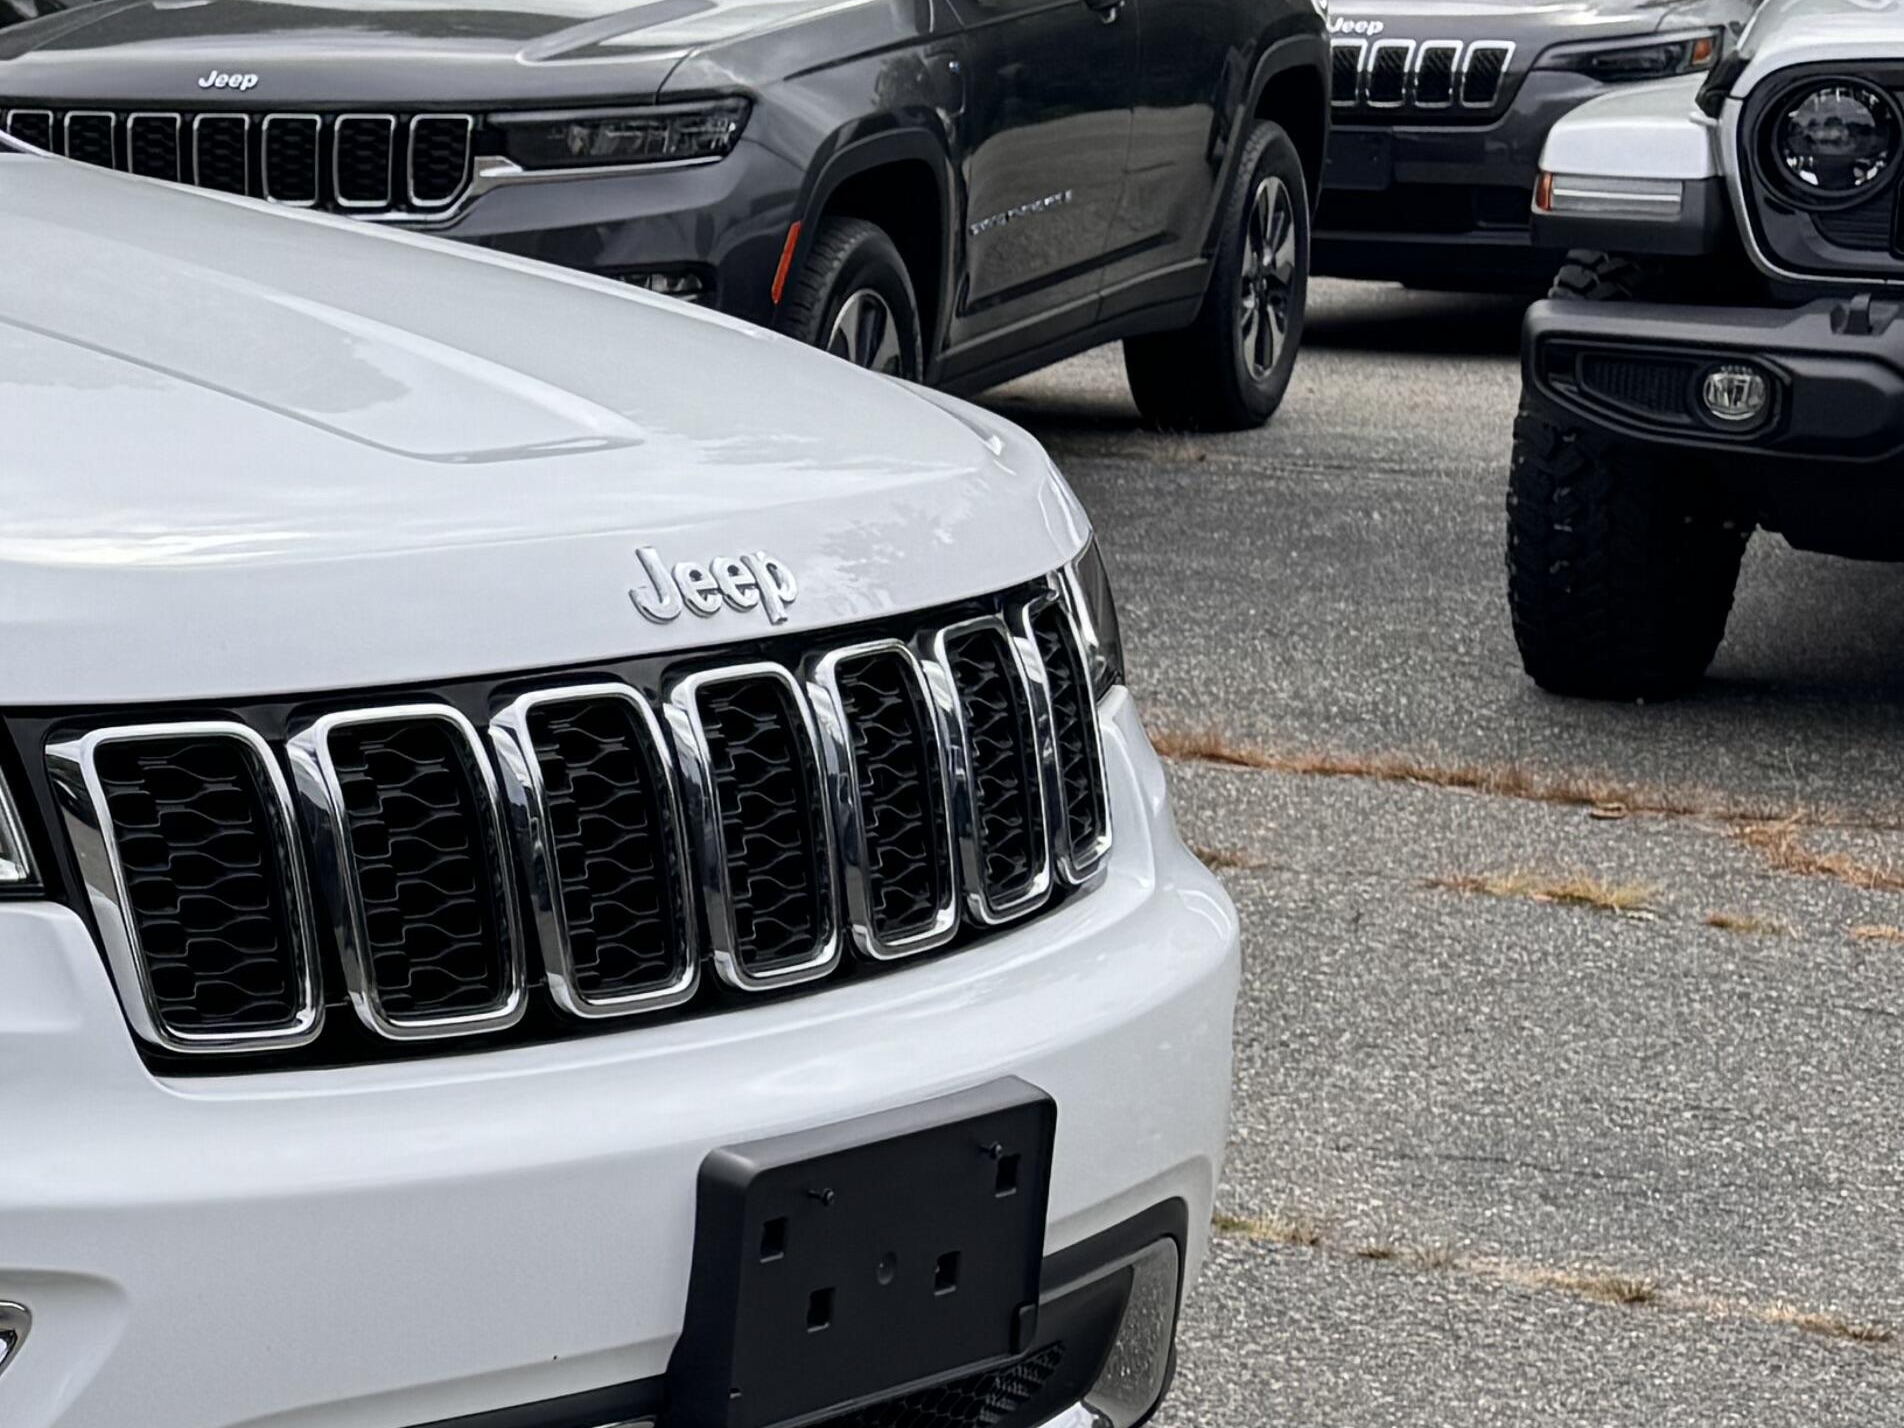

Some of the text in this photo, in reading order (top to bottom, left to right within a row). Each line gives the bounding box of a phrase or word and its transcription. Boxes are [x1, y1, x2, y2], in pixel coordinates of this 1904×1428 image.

[1326, 17, 1384, 36] Jeep
[197, 70, 259, 91] Jeep
[628, 546, 800, 626] Jeep
